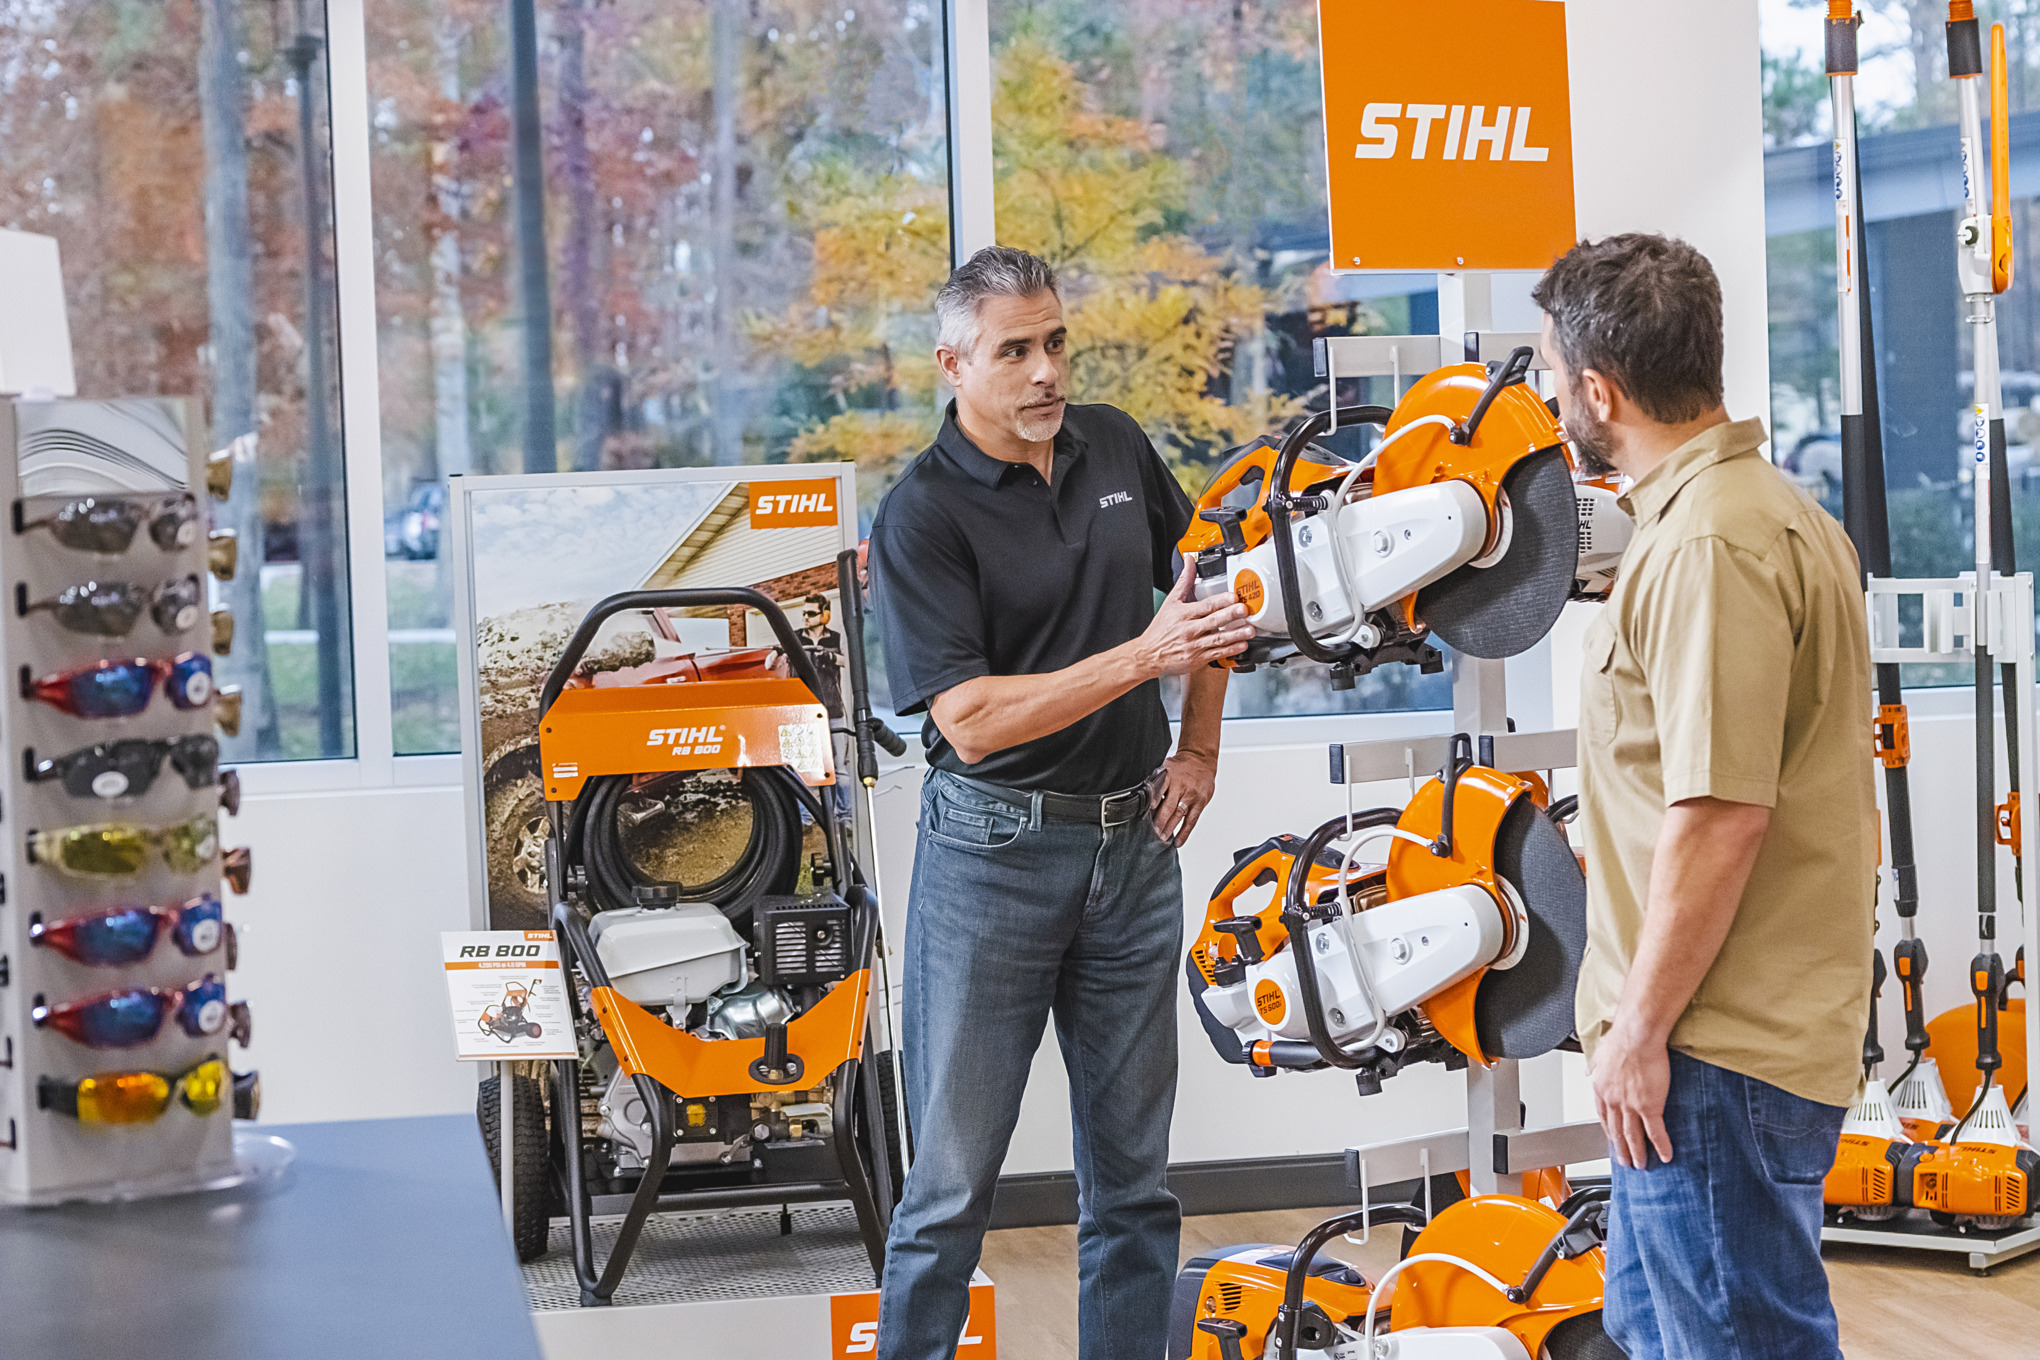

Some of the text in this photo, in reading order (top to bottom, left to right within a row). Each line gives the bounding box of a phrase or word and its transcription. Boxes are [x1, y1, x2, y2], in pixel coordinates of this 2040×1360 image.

[1354, 102, 1550, 162] STIHL
[755, 493, 834, 515] STIHL
[1099, 491, 1132, 508] STIHL
[1236, 580, 1260, 597] STIHL
[646, 726, 723, 746] STIHL
[672, 744, 721, 756] RB 800
[459, 945, 541, 958] RB 800
[1257, 990, 1280, 1007] STIHL
[1260, 1006, 1267, 1014] TS
